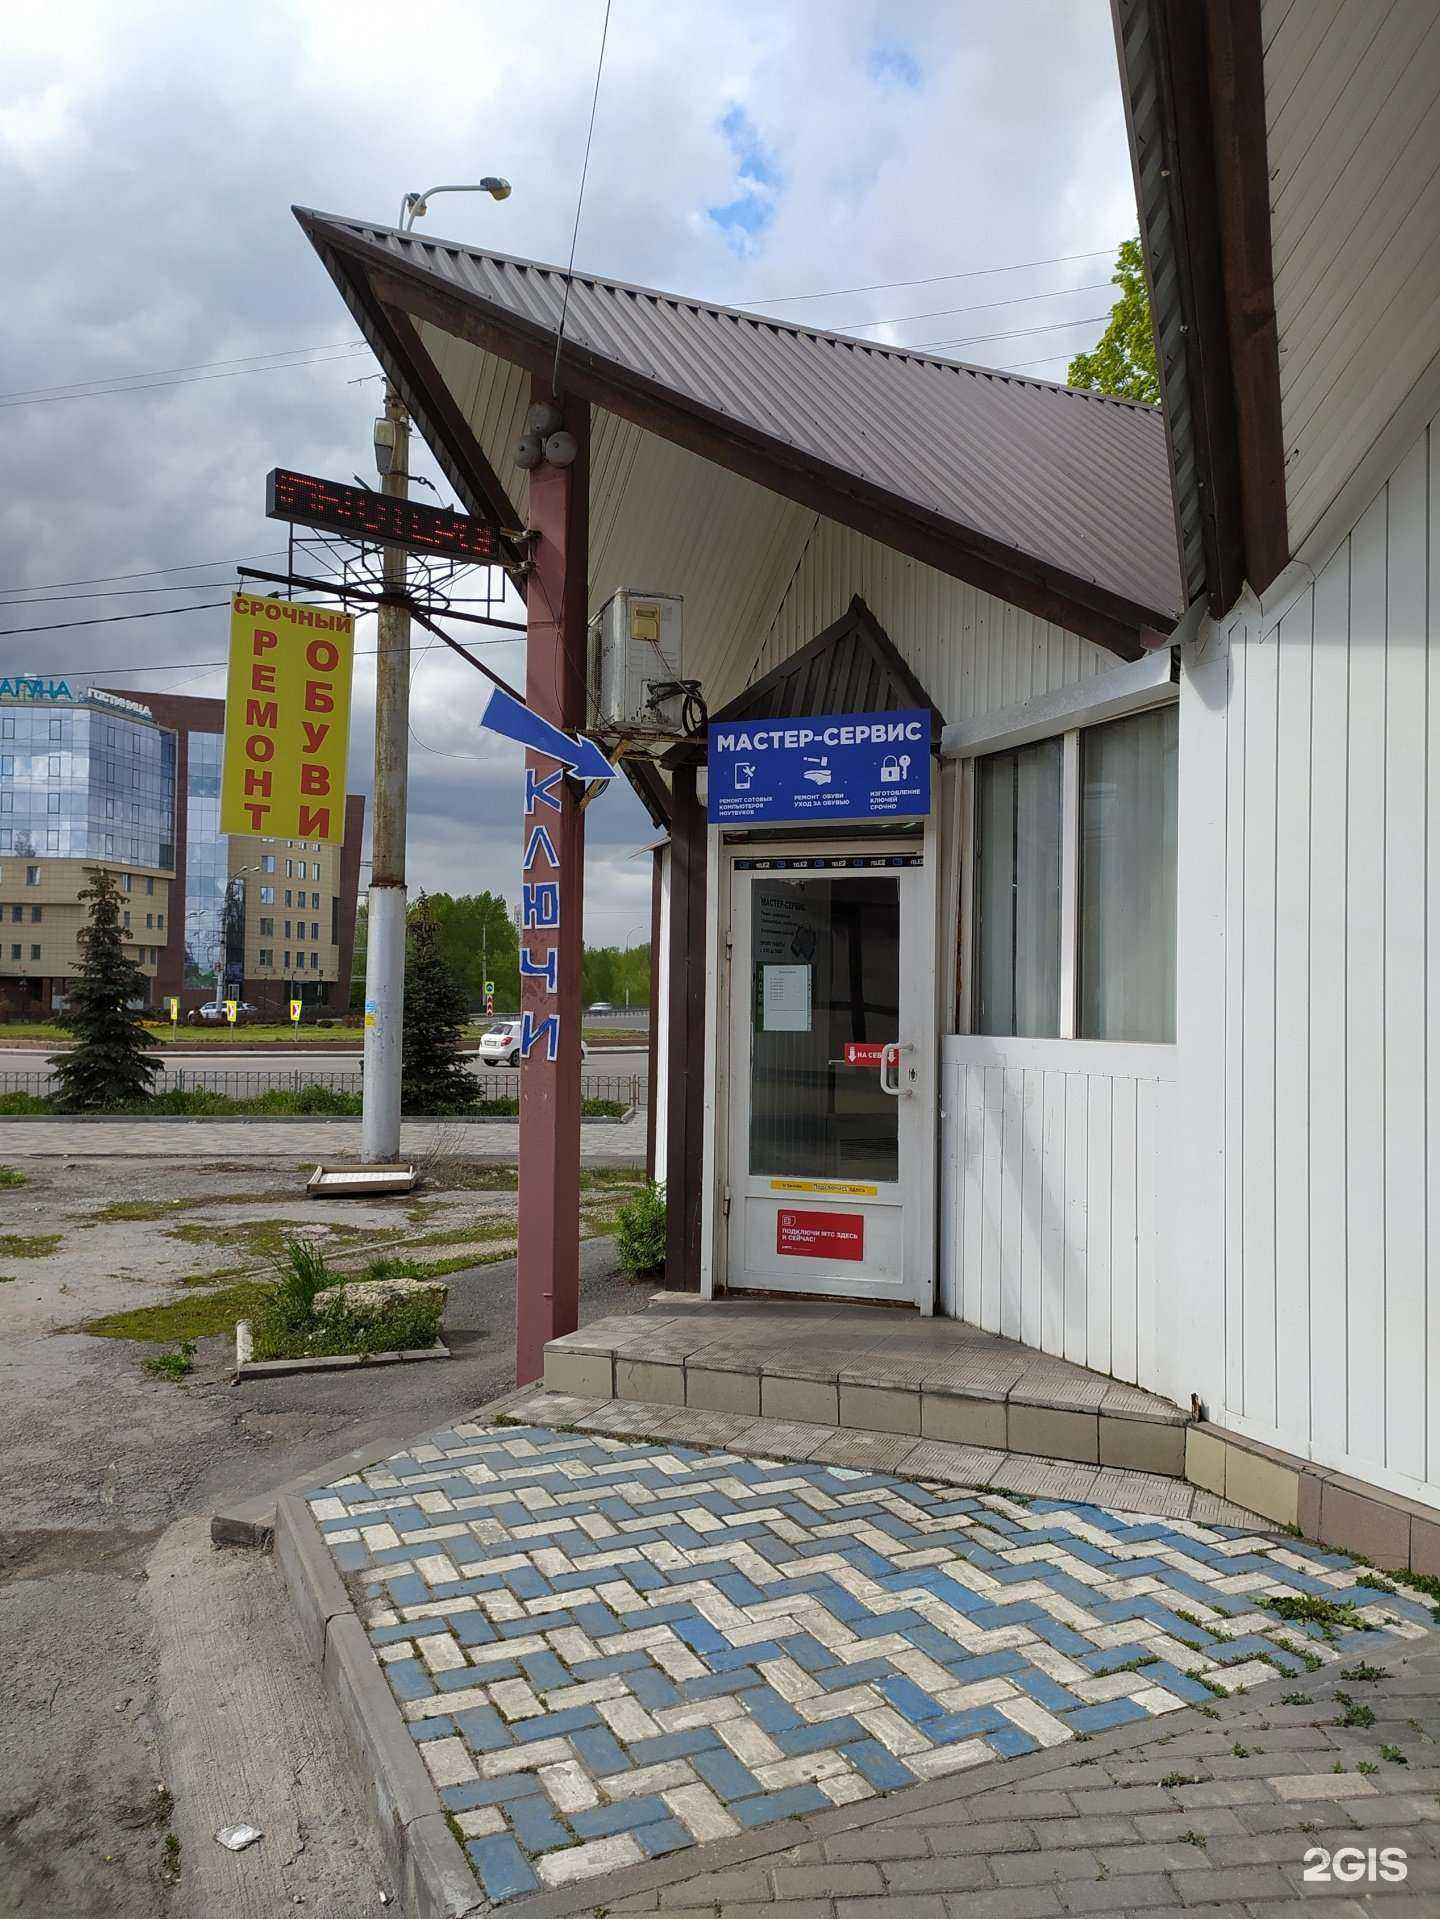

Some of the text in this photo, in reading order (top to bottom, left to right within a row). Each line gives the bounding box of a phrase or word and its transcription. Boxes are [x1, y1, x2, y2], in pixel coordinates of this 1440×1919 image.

[233, 597, 352, 634] СРОЧНЫЙ
[243, 628, 279, 831] РЕМОНТ
[297, 638, 340, 839] ОБУВИ
[717, 721, 922, 753] МАСТЕР-СЕРВИС
[870, 788, 920, 796] ИЗГОТОВЛЕНИЕ
[794, 800, 812, 808] УХОД
[870, 796, 898, 804] КЛЮЧЕЙ
[719, 803, 764, 811] КОМПЬЮТЕРОВ
[519, 767, 565, 1063] КЛЮЧИ
[857, 1051, 868, 1059] НА
[782, 1228, 858, 1240] ПОДКЛЮЧИ МТС ЗДЕСЬ
[788, 1235, 816, 1243] СЕЙЧАС!
